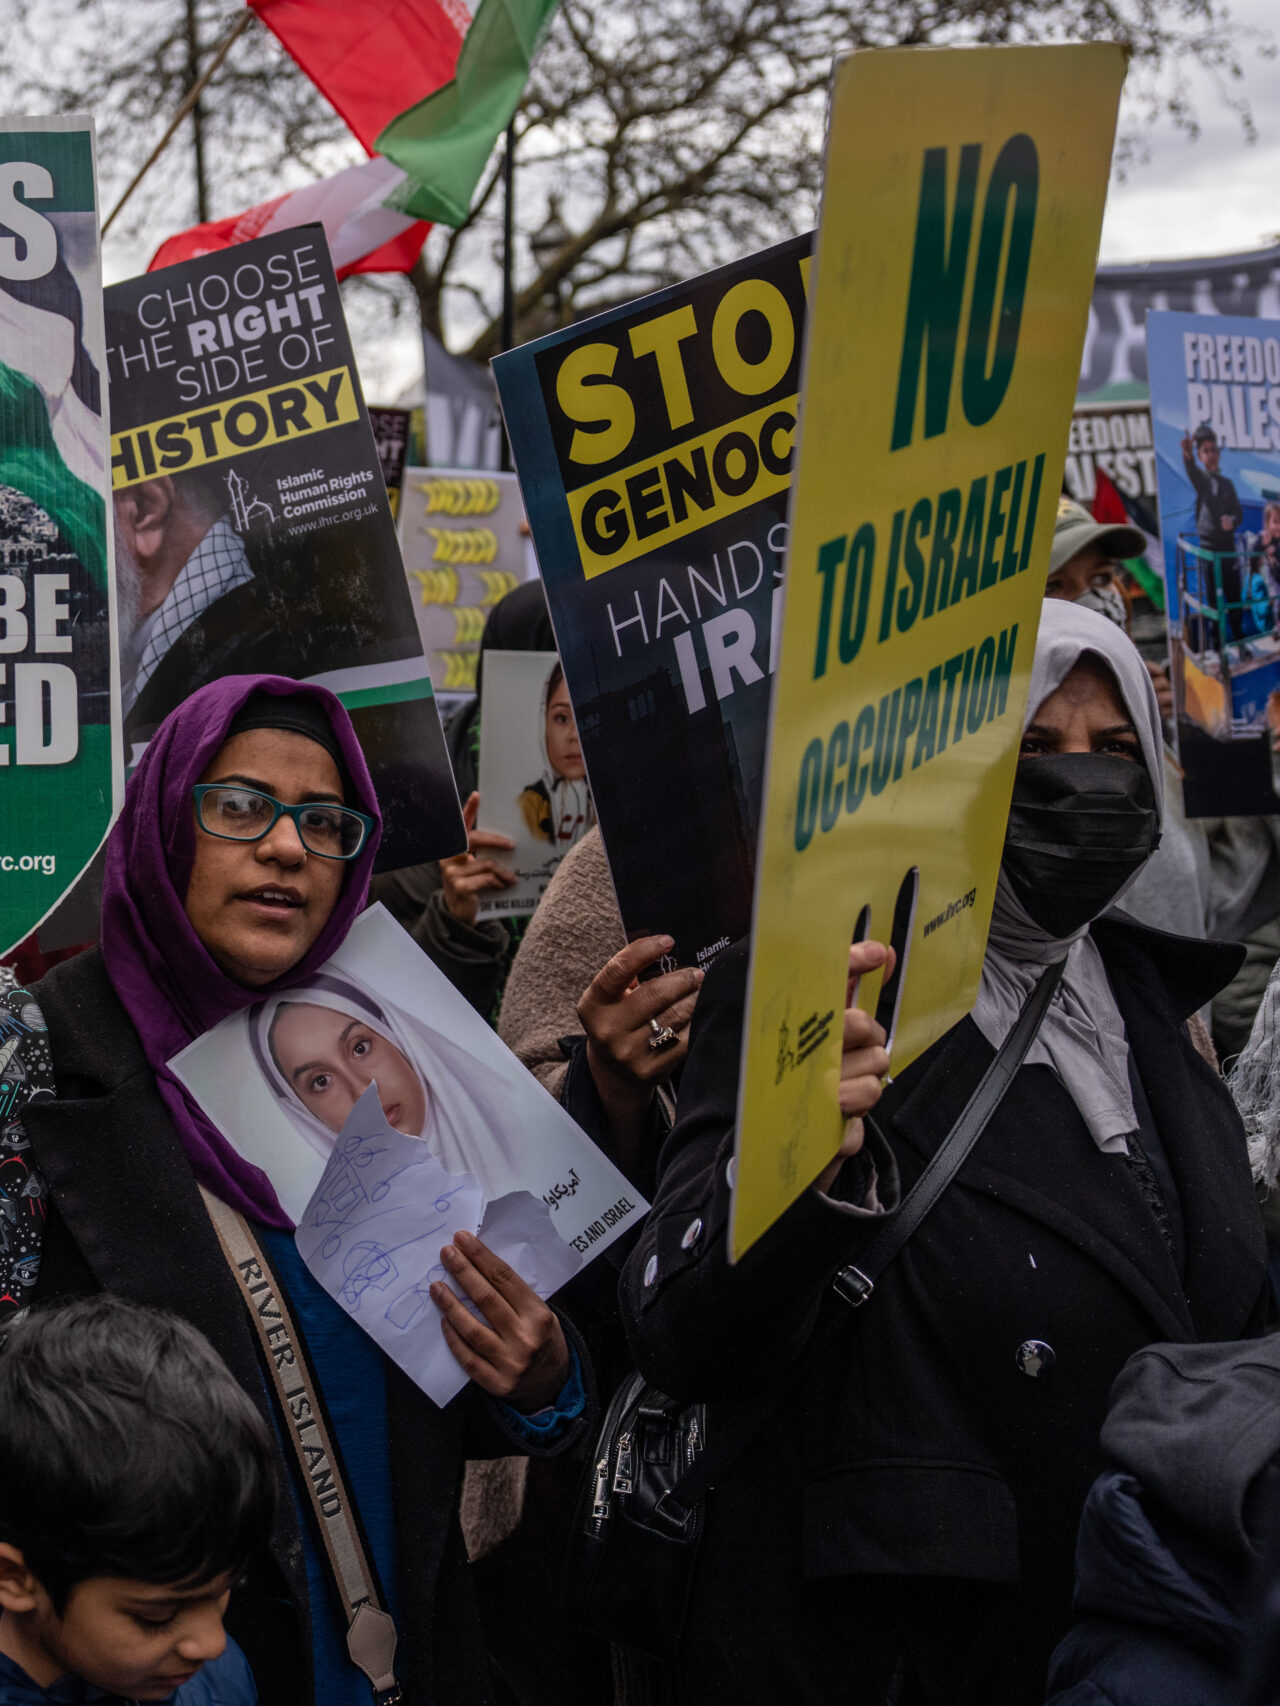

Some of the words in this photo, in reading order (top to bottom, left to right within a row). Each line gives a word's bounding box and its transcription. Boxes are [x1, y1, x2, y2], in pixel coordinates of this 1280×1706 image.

[137, 244, 321, 330] CHOOSE
[186, 283, 328, 358] RIGHT
[889, 132, 1040, 453] NO
[176, 344, 268, 401] SIDE
[278, 324, 335, 370] OF
[556, 258, 811, 466] STO
[1183, 332, 1280, 385] FREEDO
[112, 371, 346, 485] HISTORY
[276, 468, 325, 491] Islamic
[280, 483, 328, 505] Human
[329, 469, 374, 492] Rights
[283, 487, 367, 519] Commission
[288, 502, 380, 536] www.ihrc.org.uk
[812, 521, 877, 681] TO
[877, 452, 1046, 645] ISRAELI
[673, 590, 783, 715] IR
[794, 623, 1020, 853] OCCUPATION
[696, 936, 731, 963] Islamic
[583, 1220, 606, 1244] AND
[600, 1196, 636, 1228] ISRAEL
[238, 1257, 296, 1372] RIVER
[285, 1385, 345, 1519] ISLAND
